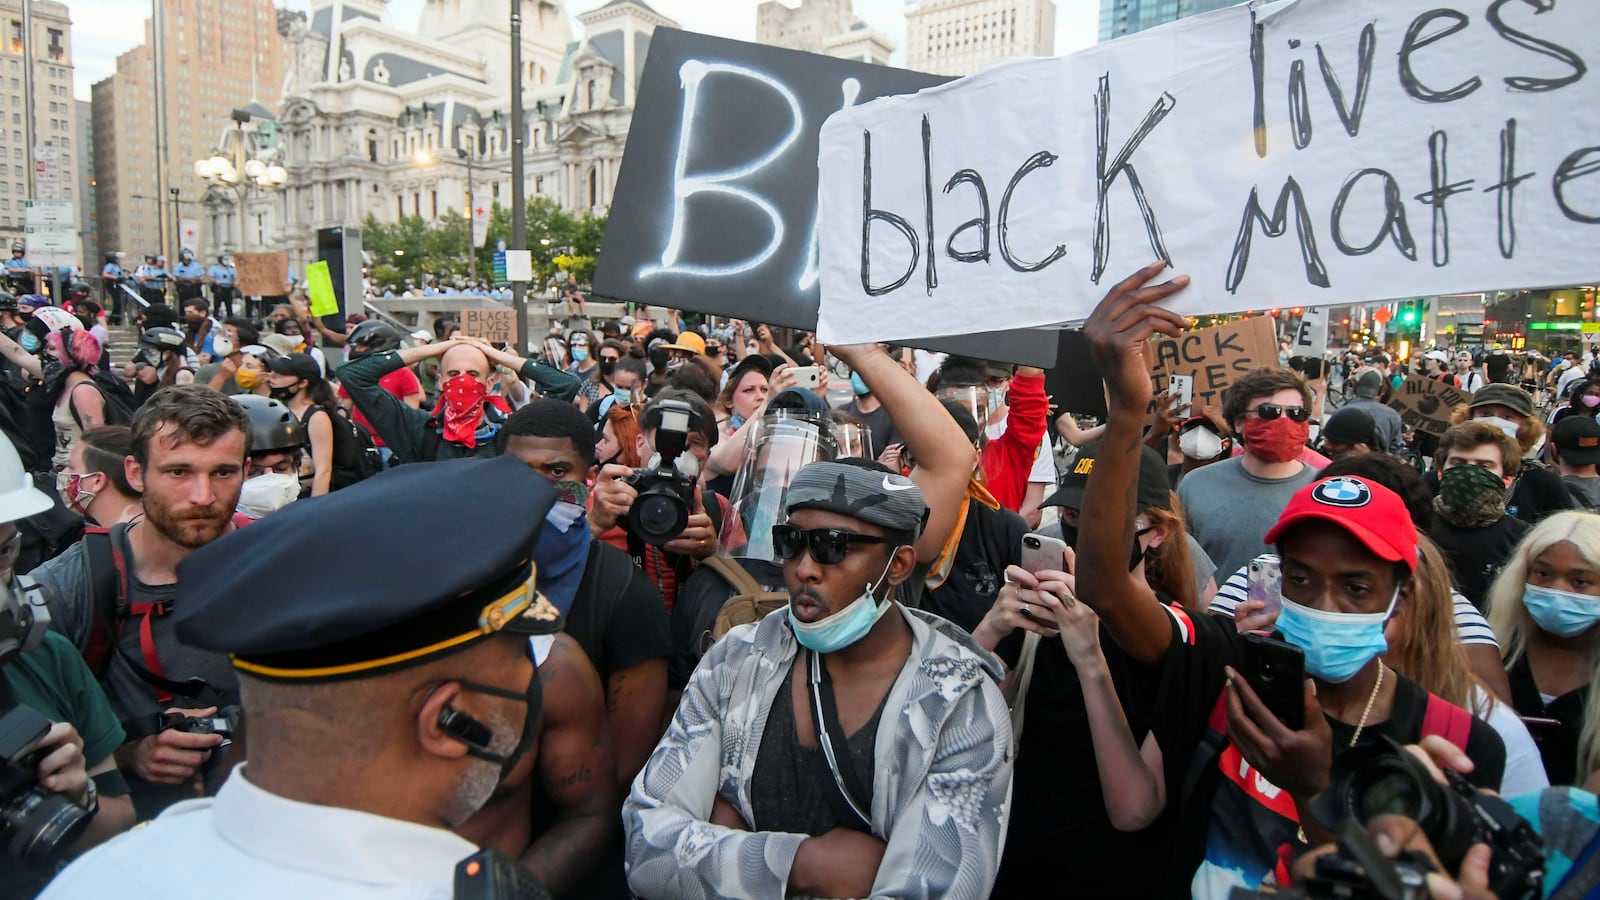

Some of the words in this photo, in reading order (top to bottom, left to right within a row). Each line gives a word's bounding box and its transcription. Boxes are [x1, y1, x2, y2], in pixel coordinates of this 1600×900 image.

[1249, 0, 1587, 158] lives
[467, 311, 510, 321] BLACK
[467, 321, 510, 331] LIVES
[1406, 381, 1436, 395] ALL
